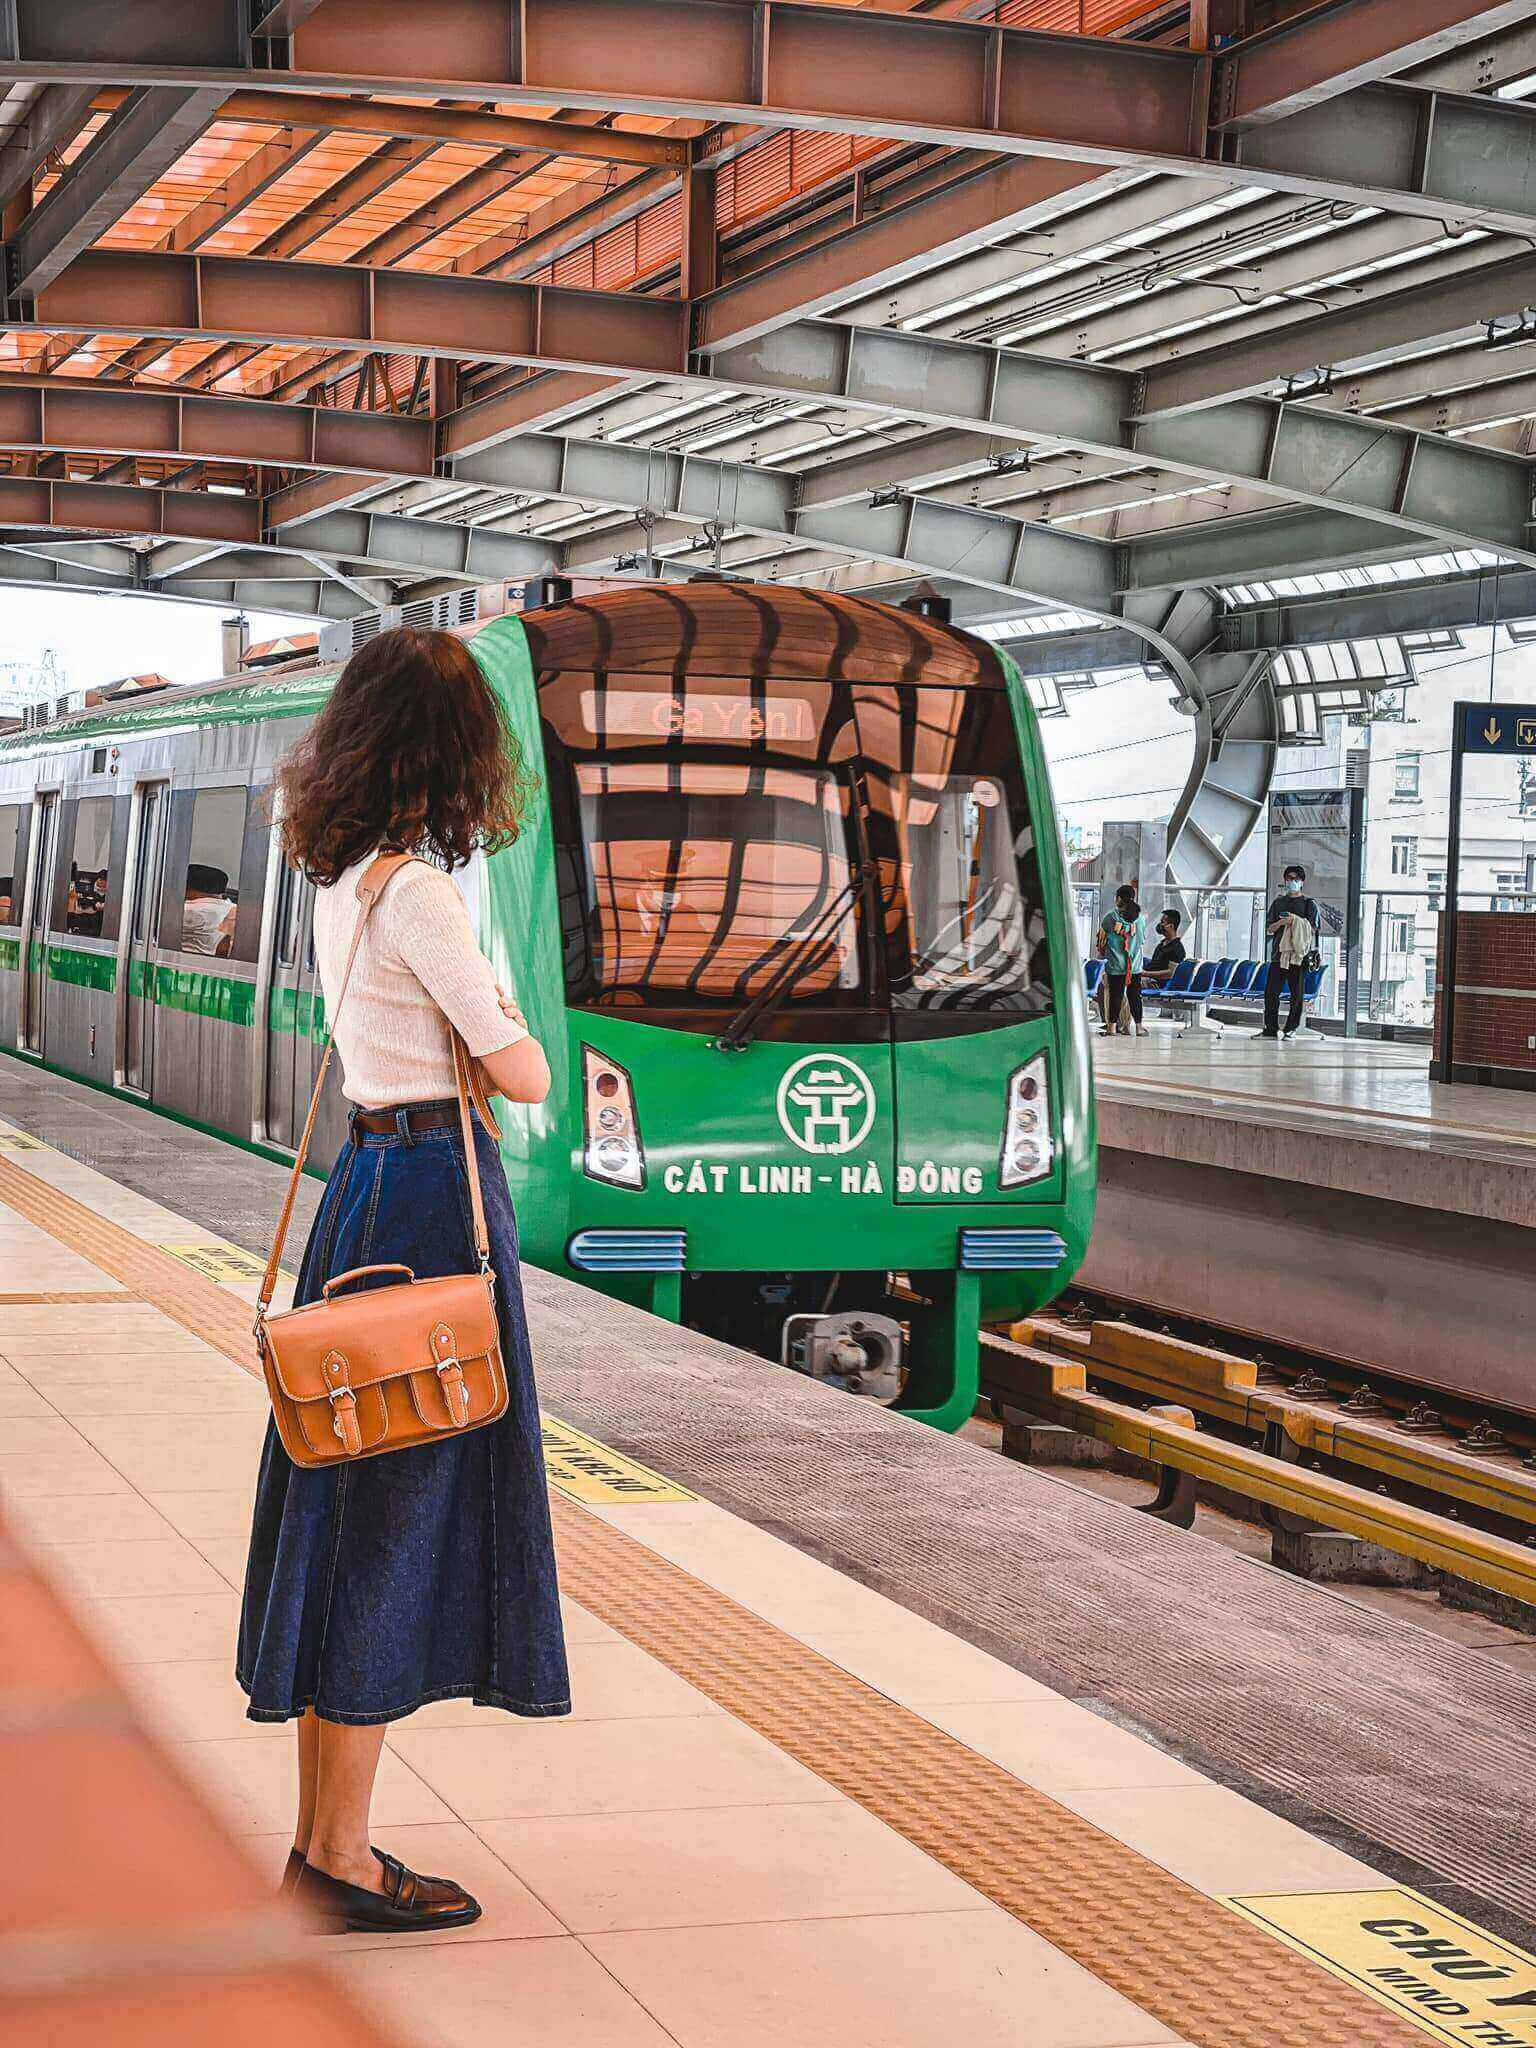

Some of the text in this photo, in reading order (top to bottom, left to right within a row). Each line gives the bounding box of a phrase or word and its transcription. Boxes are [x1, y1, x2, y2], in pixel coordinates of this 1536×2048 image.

[652, 698, 705, 736] Ga
[664, 1160, 729, 1193] CÁT
[740, 1166, 812, 1193] LINH
[841, 1161, 883, 1193] HÀ
[897, 1161, 983, 1194] ĐÔNG
[560, 1456, 624, 1476] KHE
[1360, 1919, 1517, 1980] CHÚ
[1366, 1967, 1470, 2016] MIND
